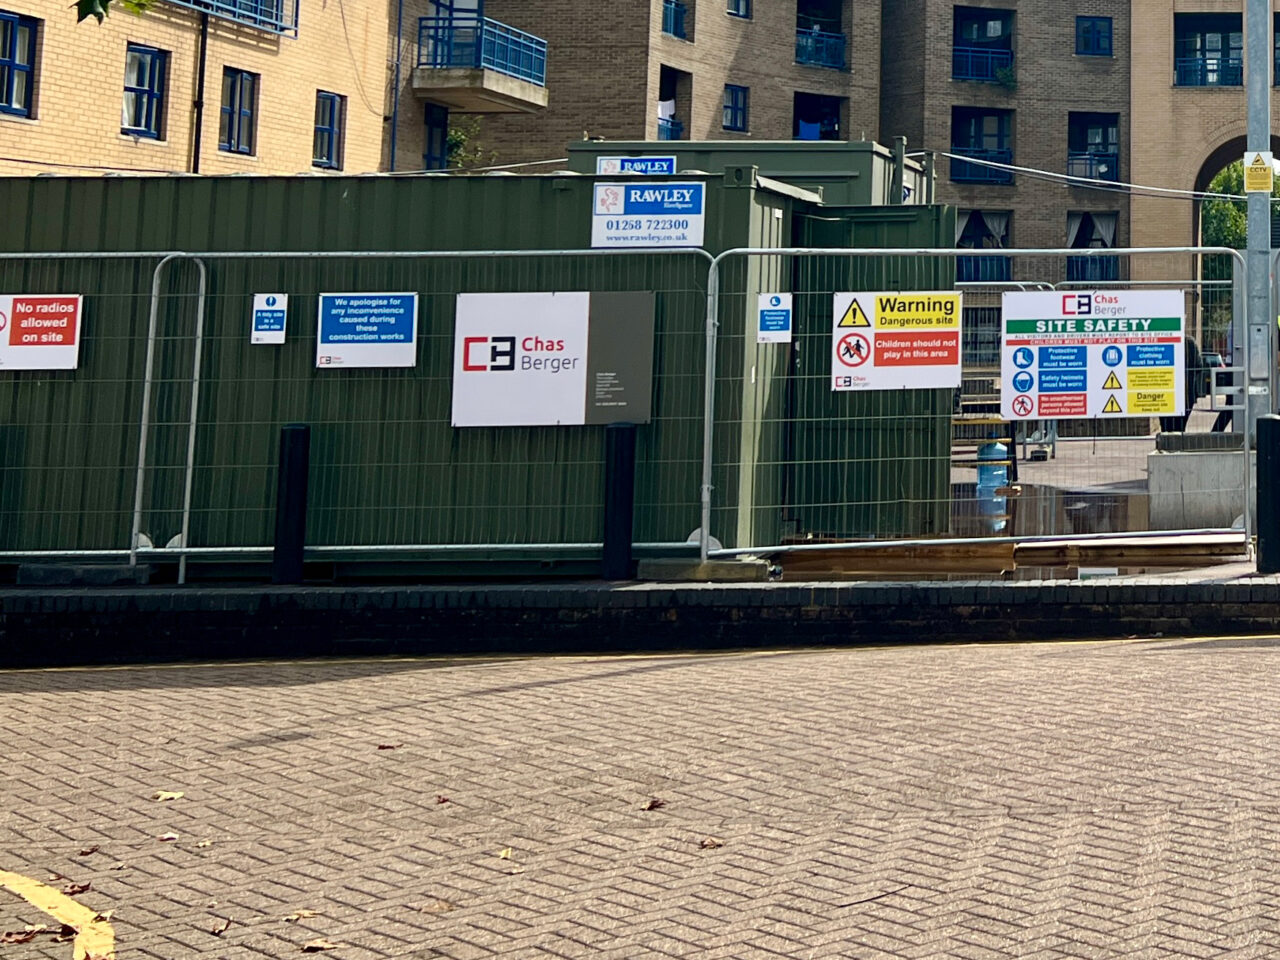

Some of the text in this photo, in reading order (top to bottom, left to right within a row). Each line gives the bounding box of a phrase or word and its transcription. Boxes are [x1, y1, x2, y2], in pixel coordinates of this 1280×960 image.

[624, 161, 670, 171] RAWLEY
[630, 189, 694, 202] RAWLEY
[646, 219, 689, 230] 722300
[335, 297, 402, 308] We apologise for
[1094, 294, 1119, 304] Chas
[16, 302, 75, 313] No radios
[331, 307, 405, 316] any inconvenience
[879, 297, 955, 315] Warning
[1094, 305, 1127, 316] Berger
[20, 317, 68, 328] allowed
[339, 316, 396, 325] caused during
[880, 316, 954, 327] Dangerous site
[1036, 319, 1152, 332] SITE SAFETY
[356, 324, 378, 332] these
[22, 331, 64, 343] on site
[328, 333, 379, 341] construction
[521, 336, 565, 352] Chas
[875, 339, 957, 348] Children should not
[883, 350, 949, 361] play in this area
[521, 355, 579, 373] Berger
[1136, 392, 1165, 402] Danger
